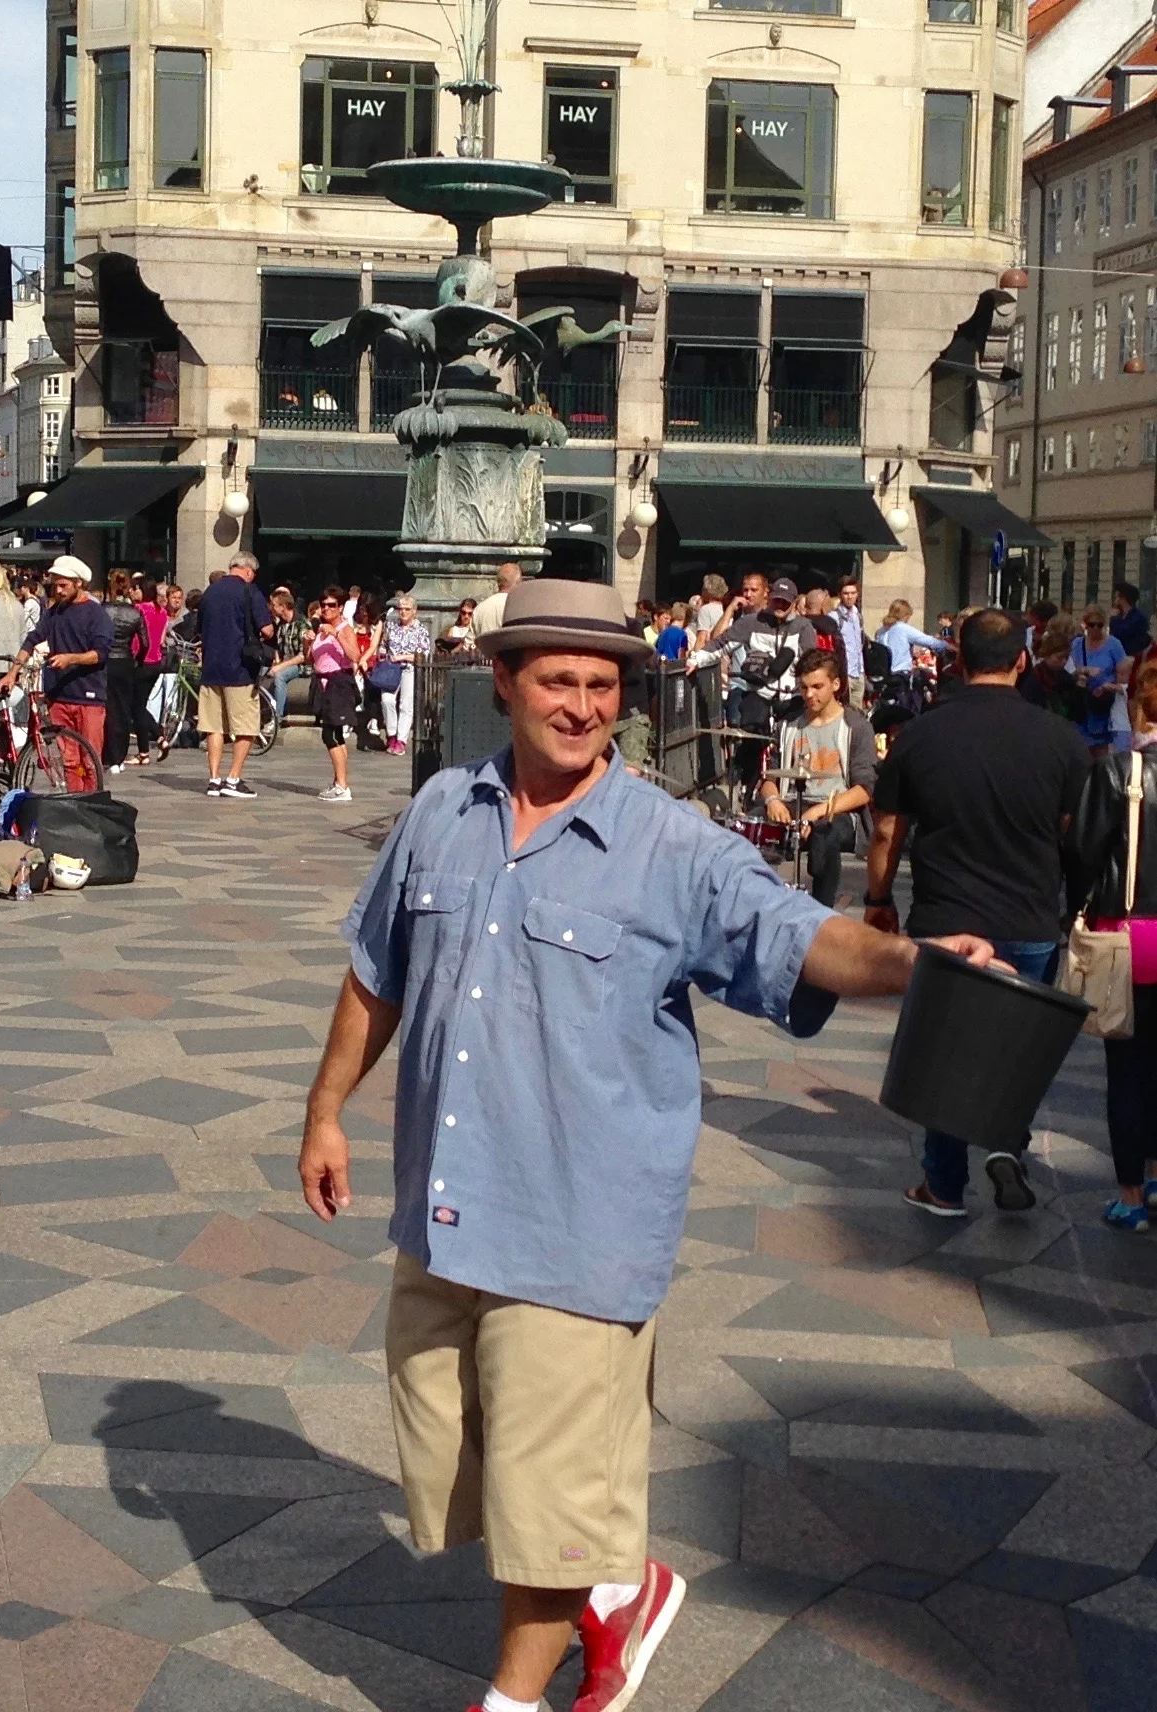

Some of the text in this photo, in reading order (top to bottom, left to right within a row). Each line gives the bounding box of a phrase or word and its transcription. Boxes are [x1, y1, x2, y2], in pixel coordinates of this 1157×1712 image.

[347, 98, 386, 117] HAY
[560, 104, 598, 123] HAY
[751, 120, 788, 137] HAY
